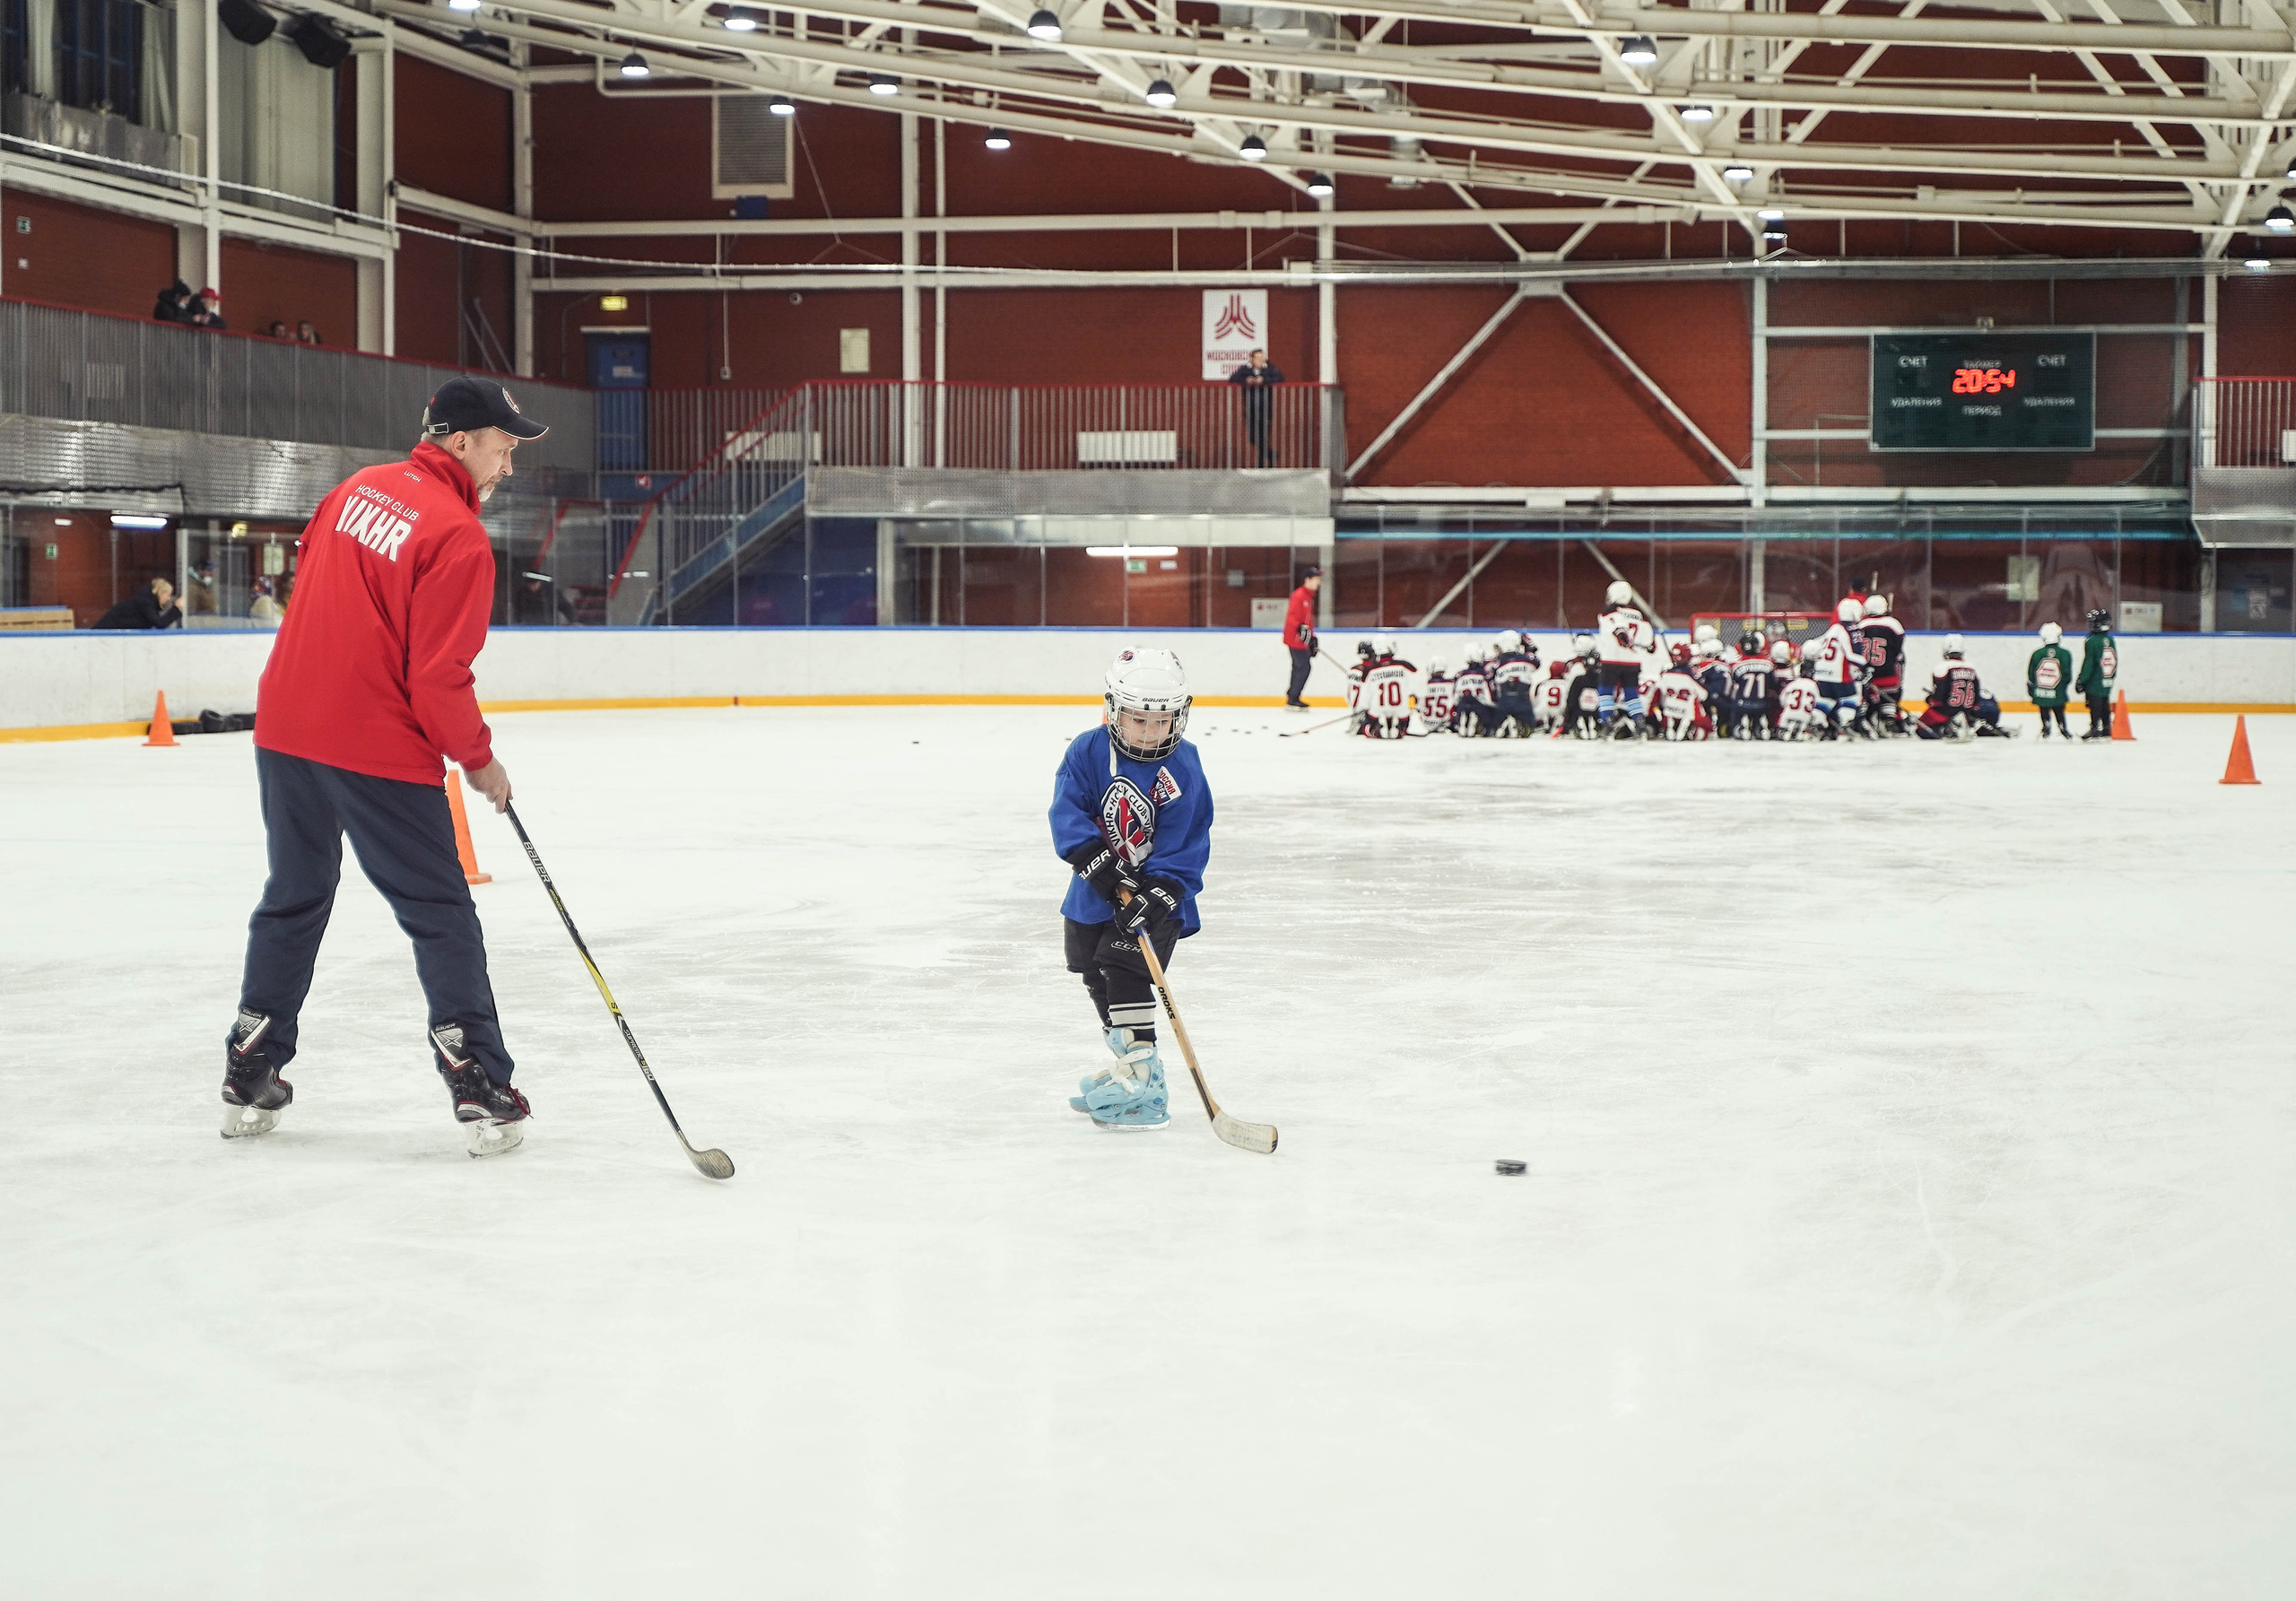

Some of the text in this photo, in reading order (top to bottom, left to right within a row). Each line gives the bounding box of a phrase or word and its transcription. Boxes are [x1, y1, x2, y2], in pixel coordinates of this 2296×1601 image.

[1898, 355, 1928, 368] СЧЕТ
[2036, 354, 2066, 367] СЧЕТ
[1952, 369, 2016, 394] 20:54
[1890, 396, 1943, 407] УДАЛЕНИЯ
[1961, 405, 2003, 416] ПЕРИОД
[2022, 396, 2076, 407] УДАЛЕНИЯ
[354, 484, 420, 521] HOCKEY CLUB
[1378, 681, 1402, 707] 10
[1548, 687, 1561, 707] 9
[1742, 673, 1766, 699] 71
[1948, 680, 1976, 709] 56
[1423, 695, 1448, 718] 55
[1789, 689, 1816, 713] 33
[1105, 812, 1121, 847] VIKHR
[1128, 794, 1148, 817] CLUB
[524, 841, 551, 883] BAUER
[1114, 940, 1143, 953] CCM
[1157, 986, 1177, 1020] OROKS
